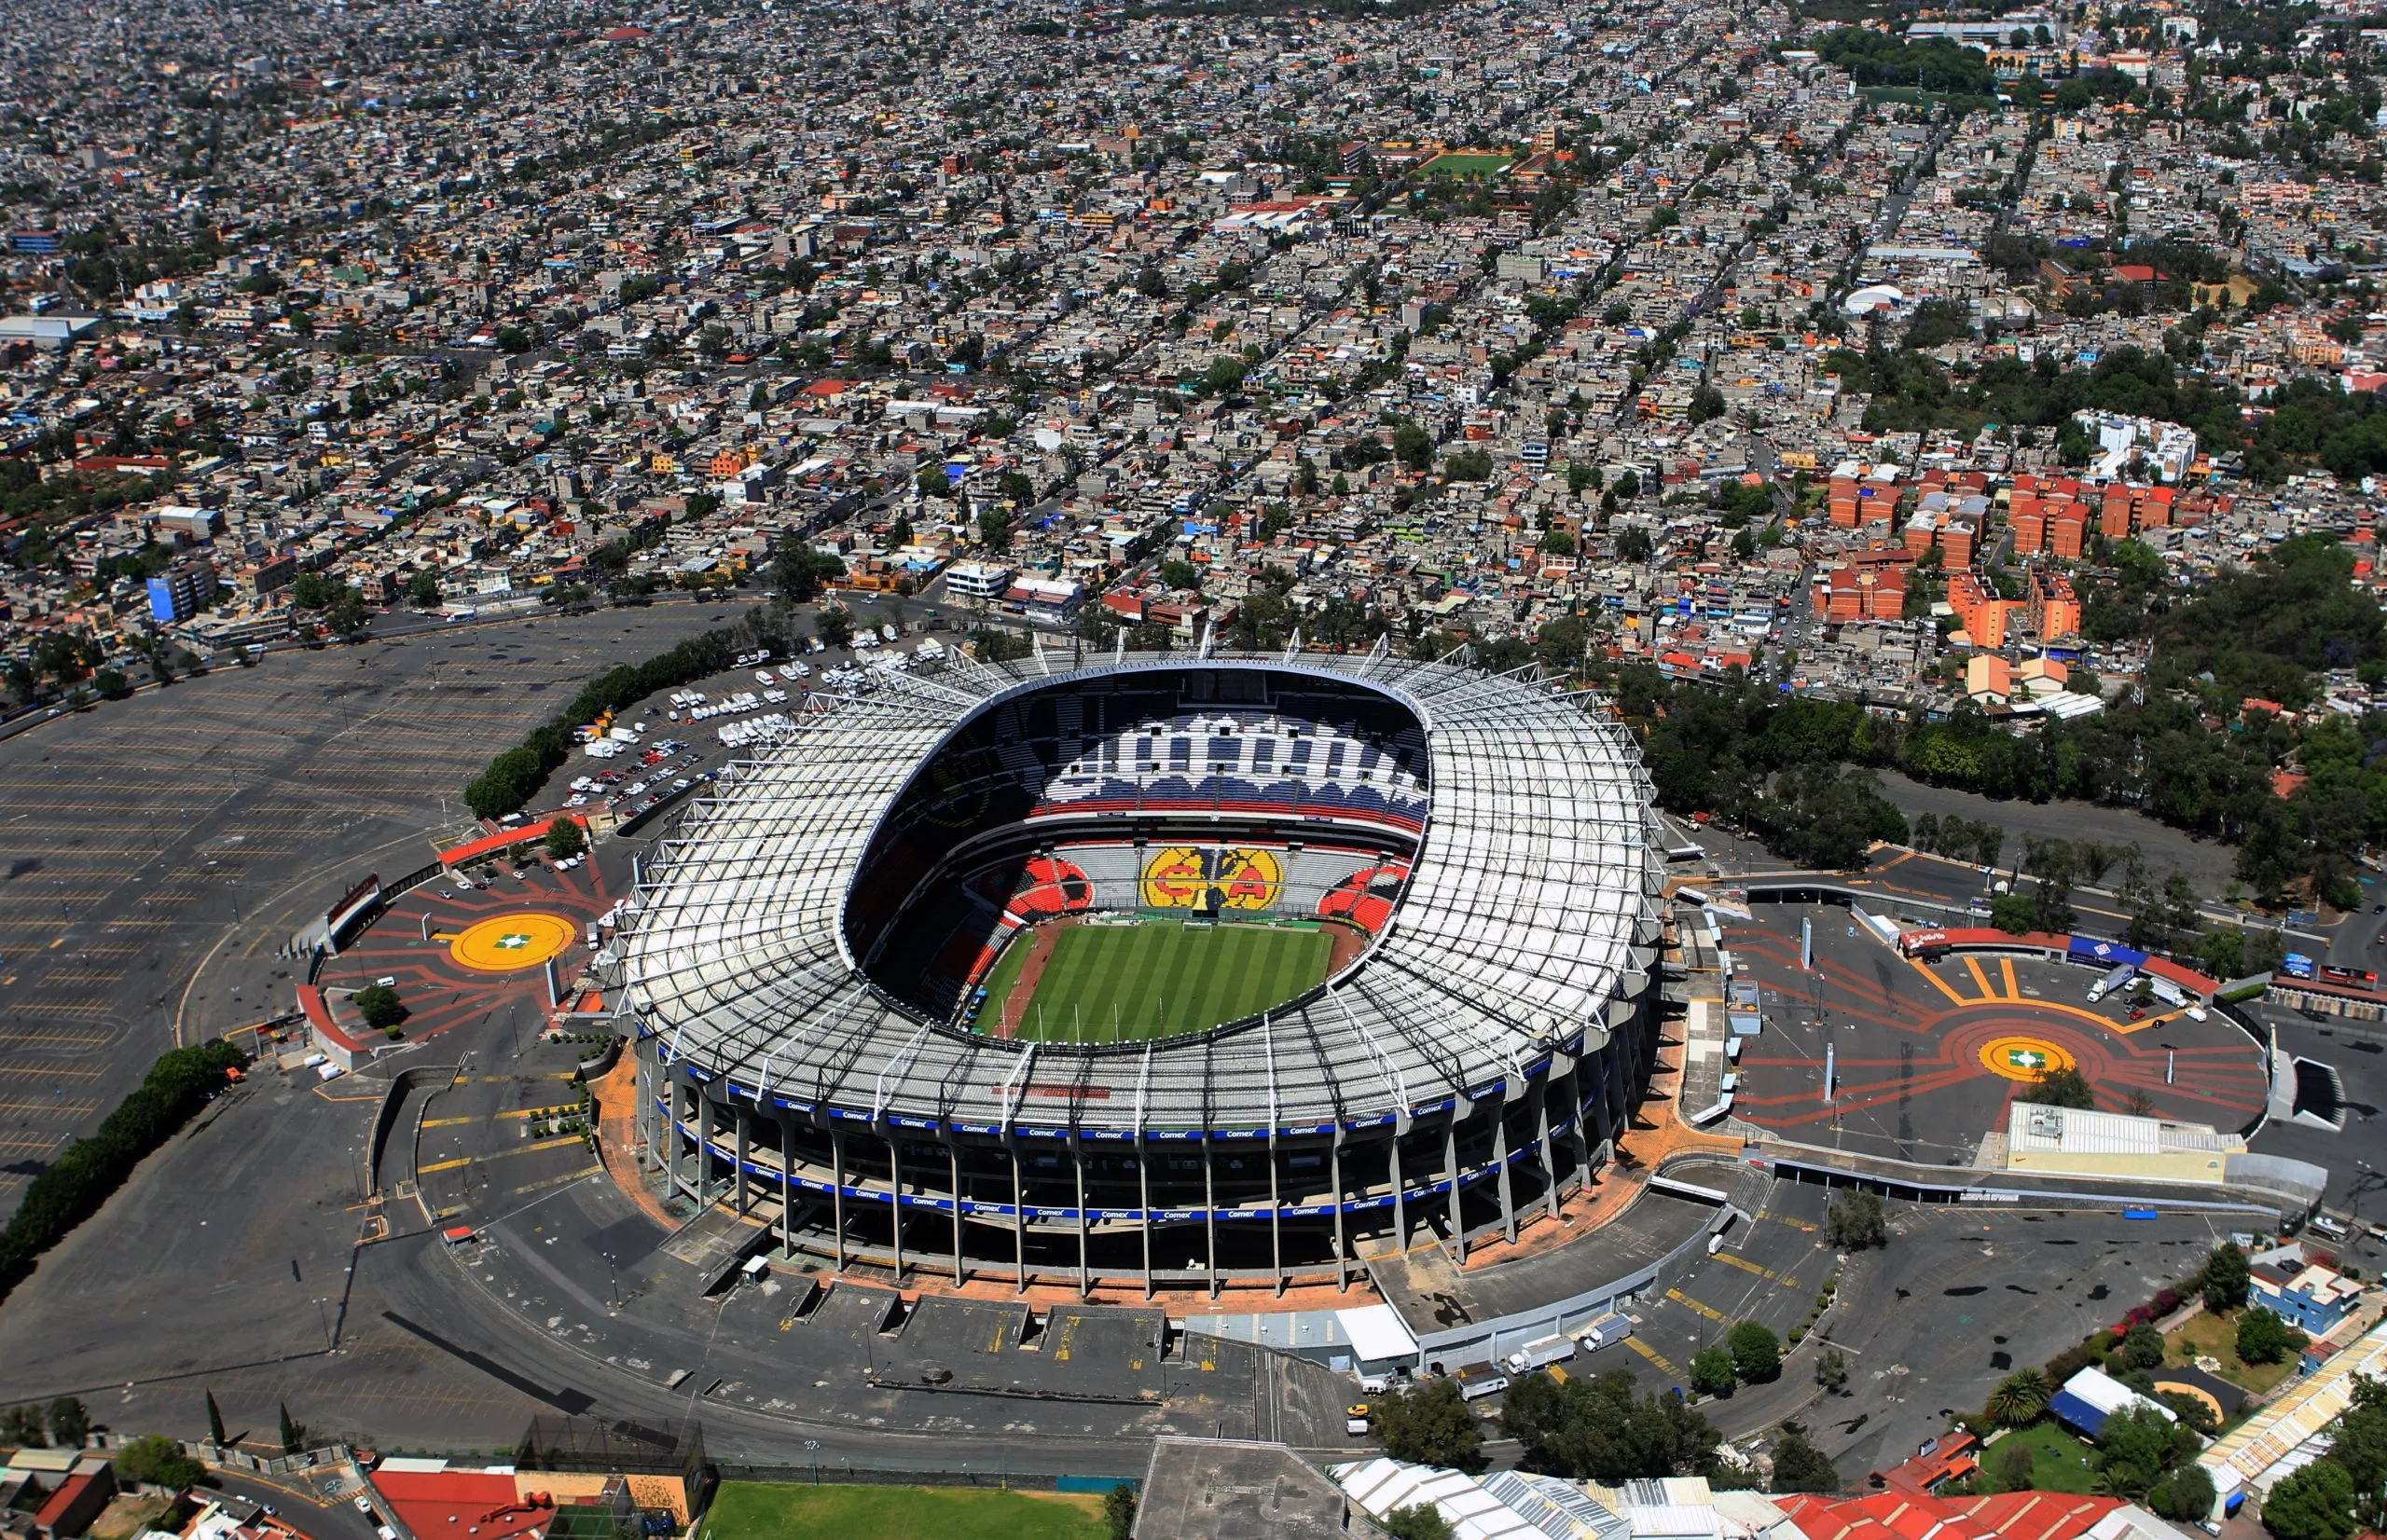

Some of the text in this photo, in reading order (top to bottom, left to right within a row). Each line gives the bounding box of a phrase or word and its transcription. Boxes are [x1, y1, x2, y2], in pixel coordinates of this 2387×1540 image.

[1471, 1087, 1494, 1100] Comex
[787, 1102, 811, 1112] Comex
[1417, 1103, 1442, 1115] Comex
[842, 1111, 868, 1121] Comex
[900, 1119, 927, 1128] Comex
[1355, 1117, 1384, 1128] Comex
[961, 1124, 990, 1134] Comex
[1028, 1129, 1057, 1137] Comex
[1226, 1130, 1256, 1138] Comex
[1290, 1126, 1319, 1135] Comex
[1095, 1131, 1124, 1139] Comex
[1159, 1131, 1189, 1139] Comex
[713, 1148, 732, 1162] Comex
[754, 1167, 778, 1178] Comex
[801, 1179, 826, 1190] Comex
[855, 1189, 881, 1200] Comex
[1413, 1185, 1438, 1198] Comex
[912, 1197, 939, 1206] Comex
[1353, 1199, 1382, 1210] Comex
[973, 1204, 1000, 1213] Comex
[1291, 1206, 1321, 1216] Comex
[1101, 1211, 1129, 1219] Comex
[1164, 1211, 1193, 1219] Comex
[1227, 1210, 1257, 1218] Comex
